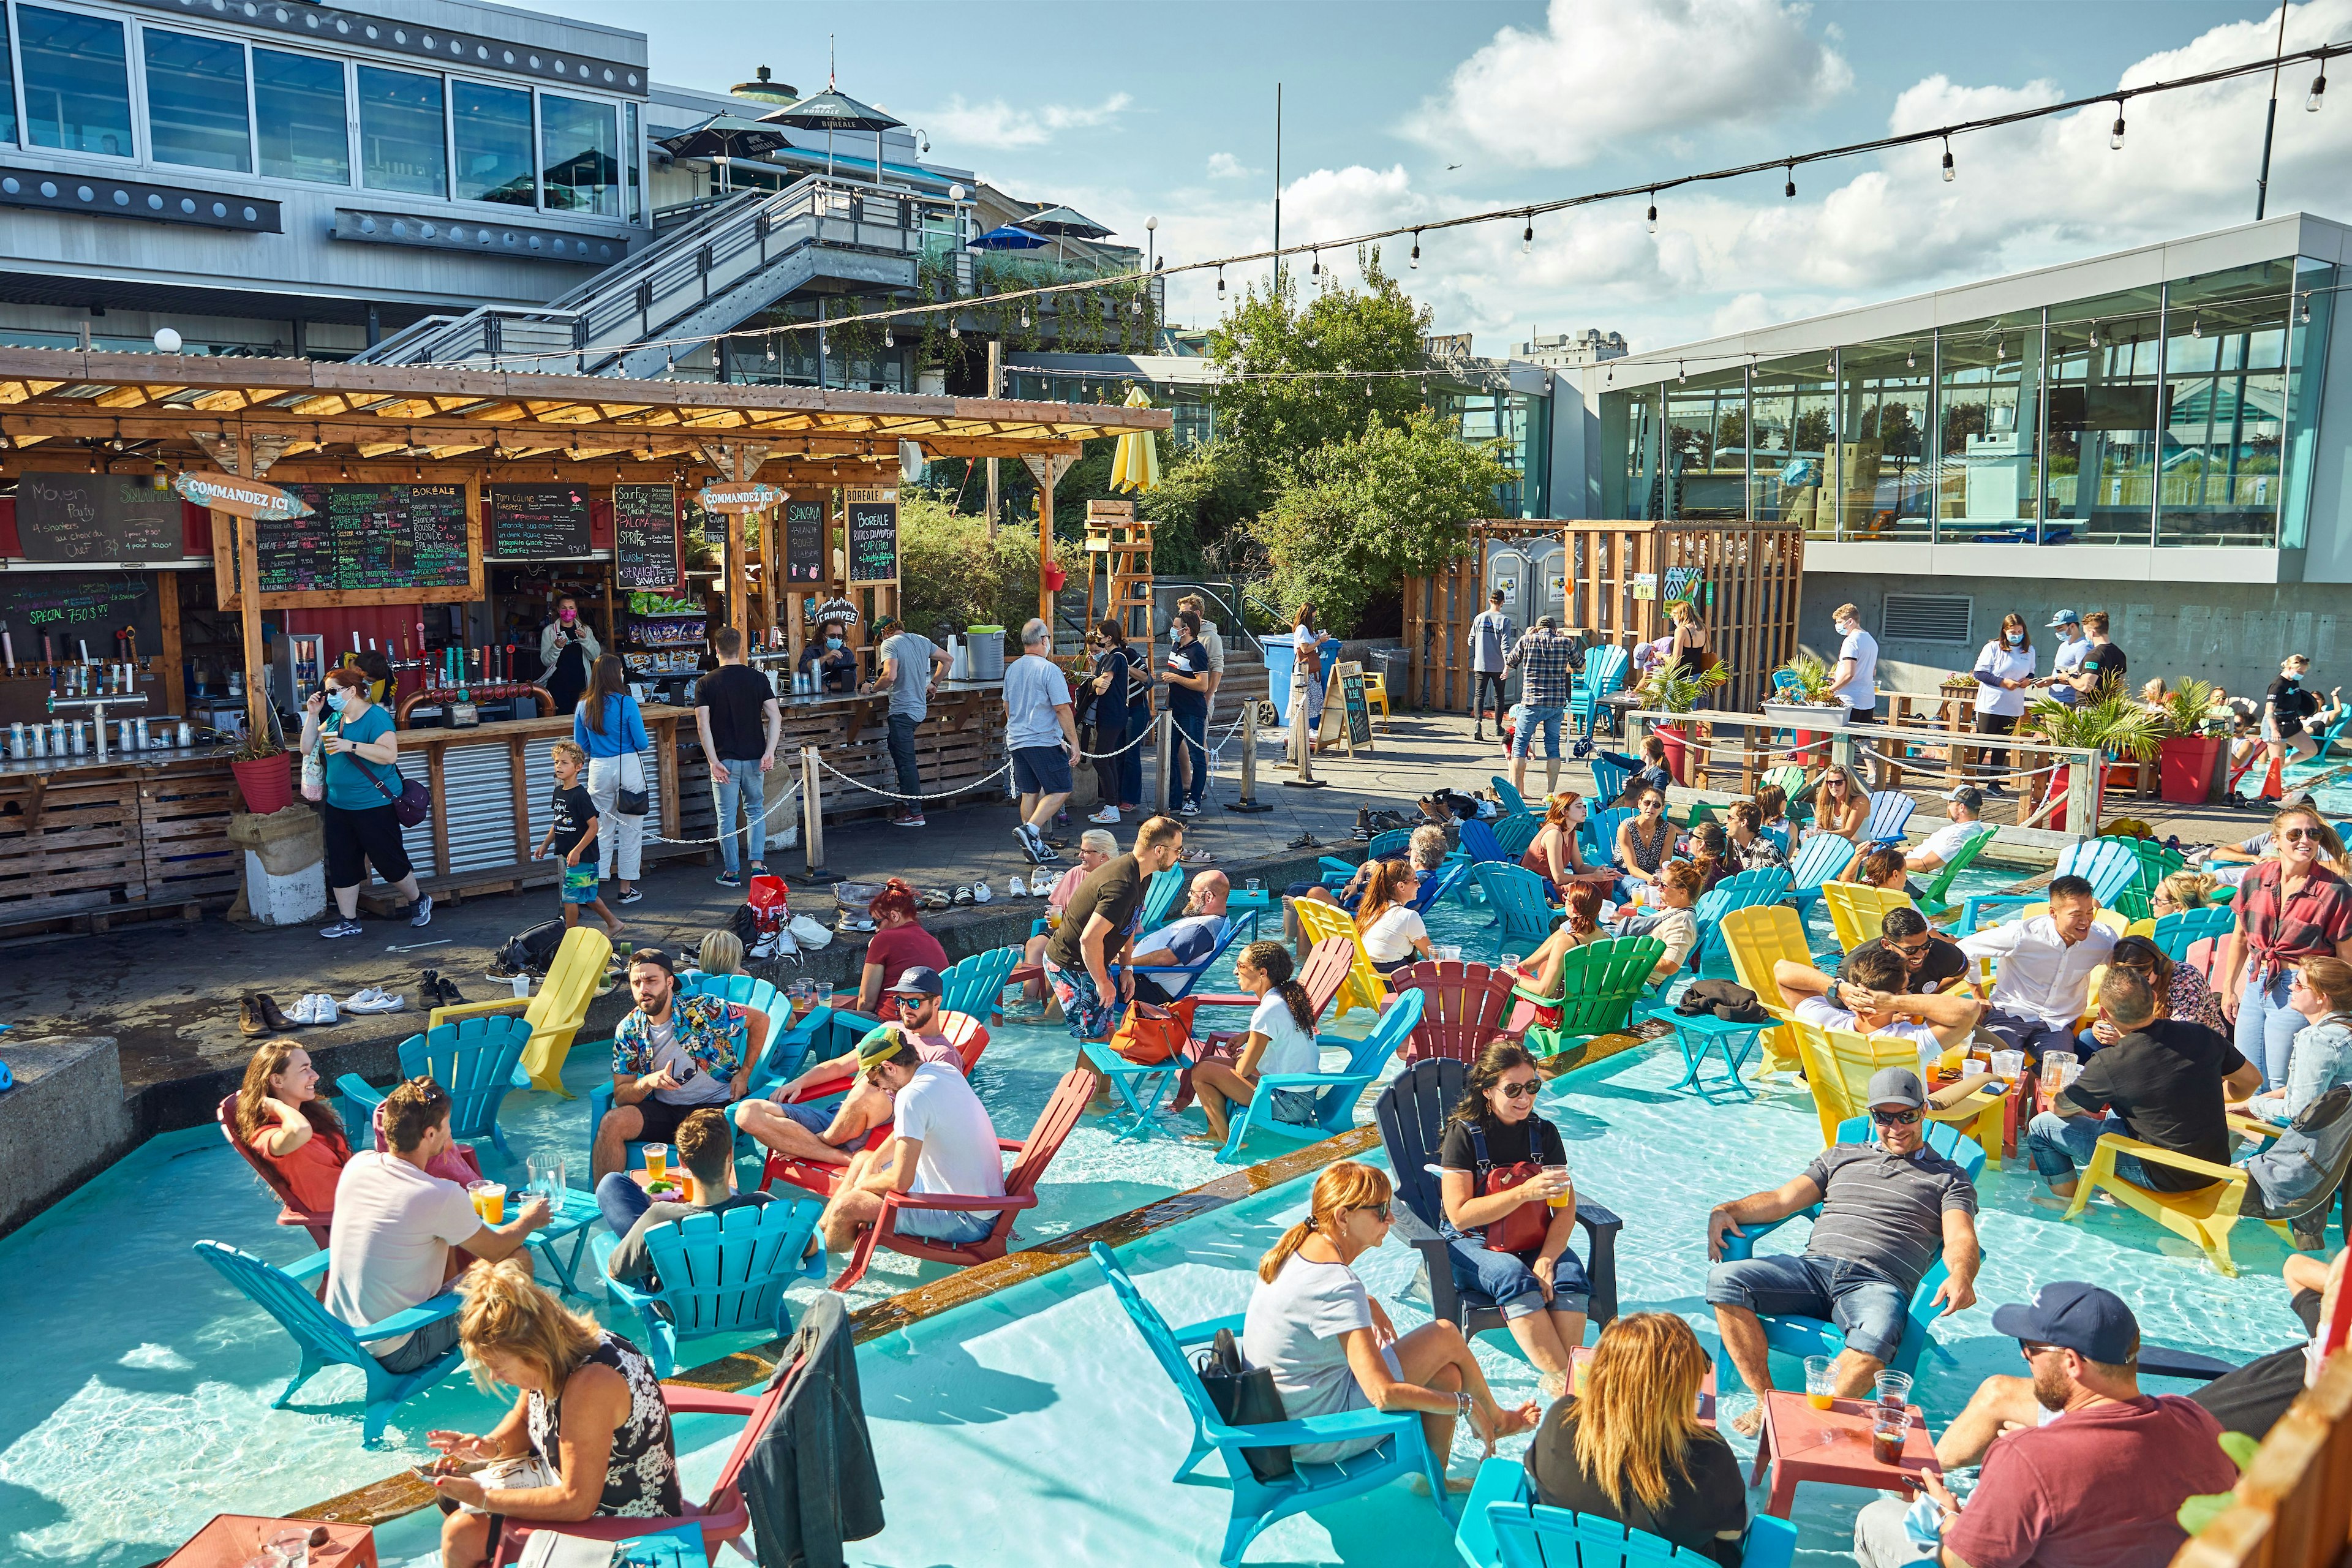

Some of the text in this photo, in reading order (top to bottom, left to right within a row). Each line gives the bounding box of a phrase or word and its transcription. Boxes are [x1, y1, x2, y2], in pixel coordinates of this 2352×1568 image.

[32, 483, 88, 508] Moyen
[120, 484, 177, 503] SNAPPLE
[189, 480, 288, 511] COMMANDEZ ICI
[412, 486, 455, 497] BORÉALE
[847, 490, 879, 502] BORÉALE
[706, 492, 774, 505] COMMANDEZ ICI
[67, 504, 94, 521] Party
[790, 505, 821, 526] SANGRIA
[620, 514, 649, 527] PALOMA
[858, 512, 889, 528] BORÉALE
[33, 522, 79, 533] 4 shooters
[793, 527, 818, 535] BLANCHE
[70, 532, 91, 540] choix
[415, 541, 426, 550] IPA
[793, 538, 815, 548] ROUGE
[863, 540, 875, 551] CAP
[619, 550, 644, 563] Twisted
[635, 576, 666, 586] SAVAGE
[29, 608, 65, 625] SPÉCIAL
[819, 611, 856, 623] CANOPÉE
[1662, 911, 1677, 920] LOVE
[1811, 1388, 1828, 1396] BAY
